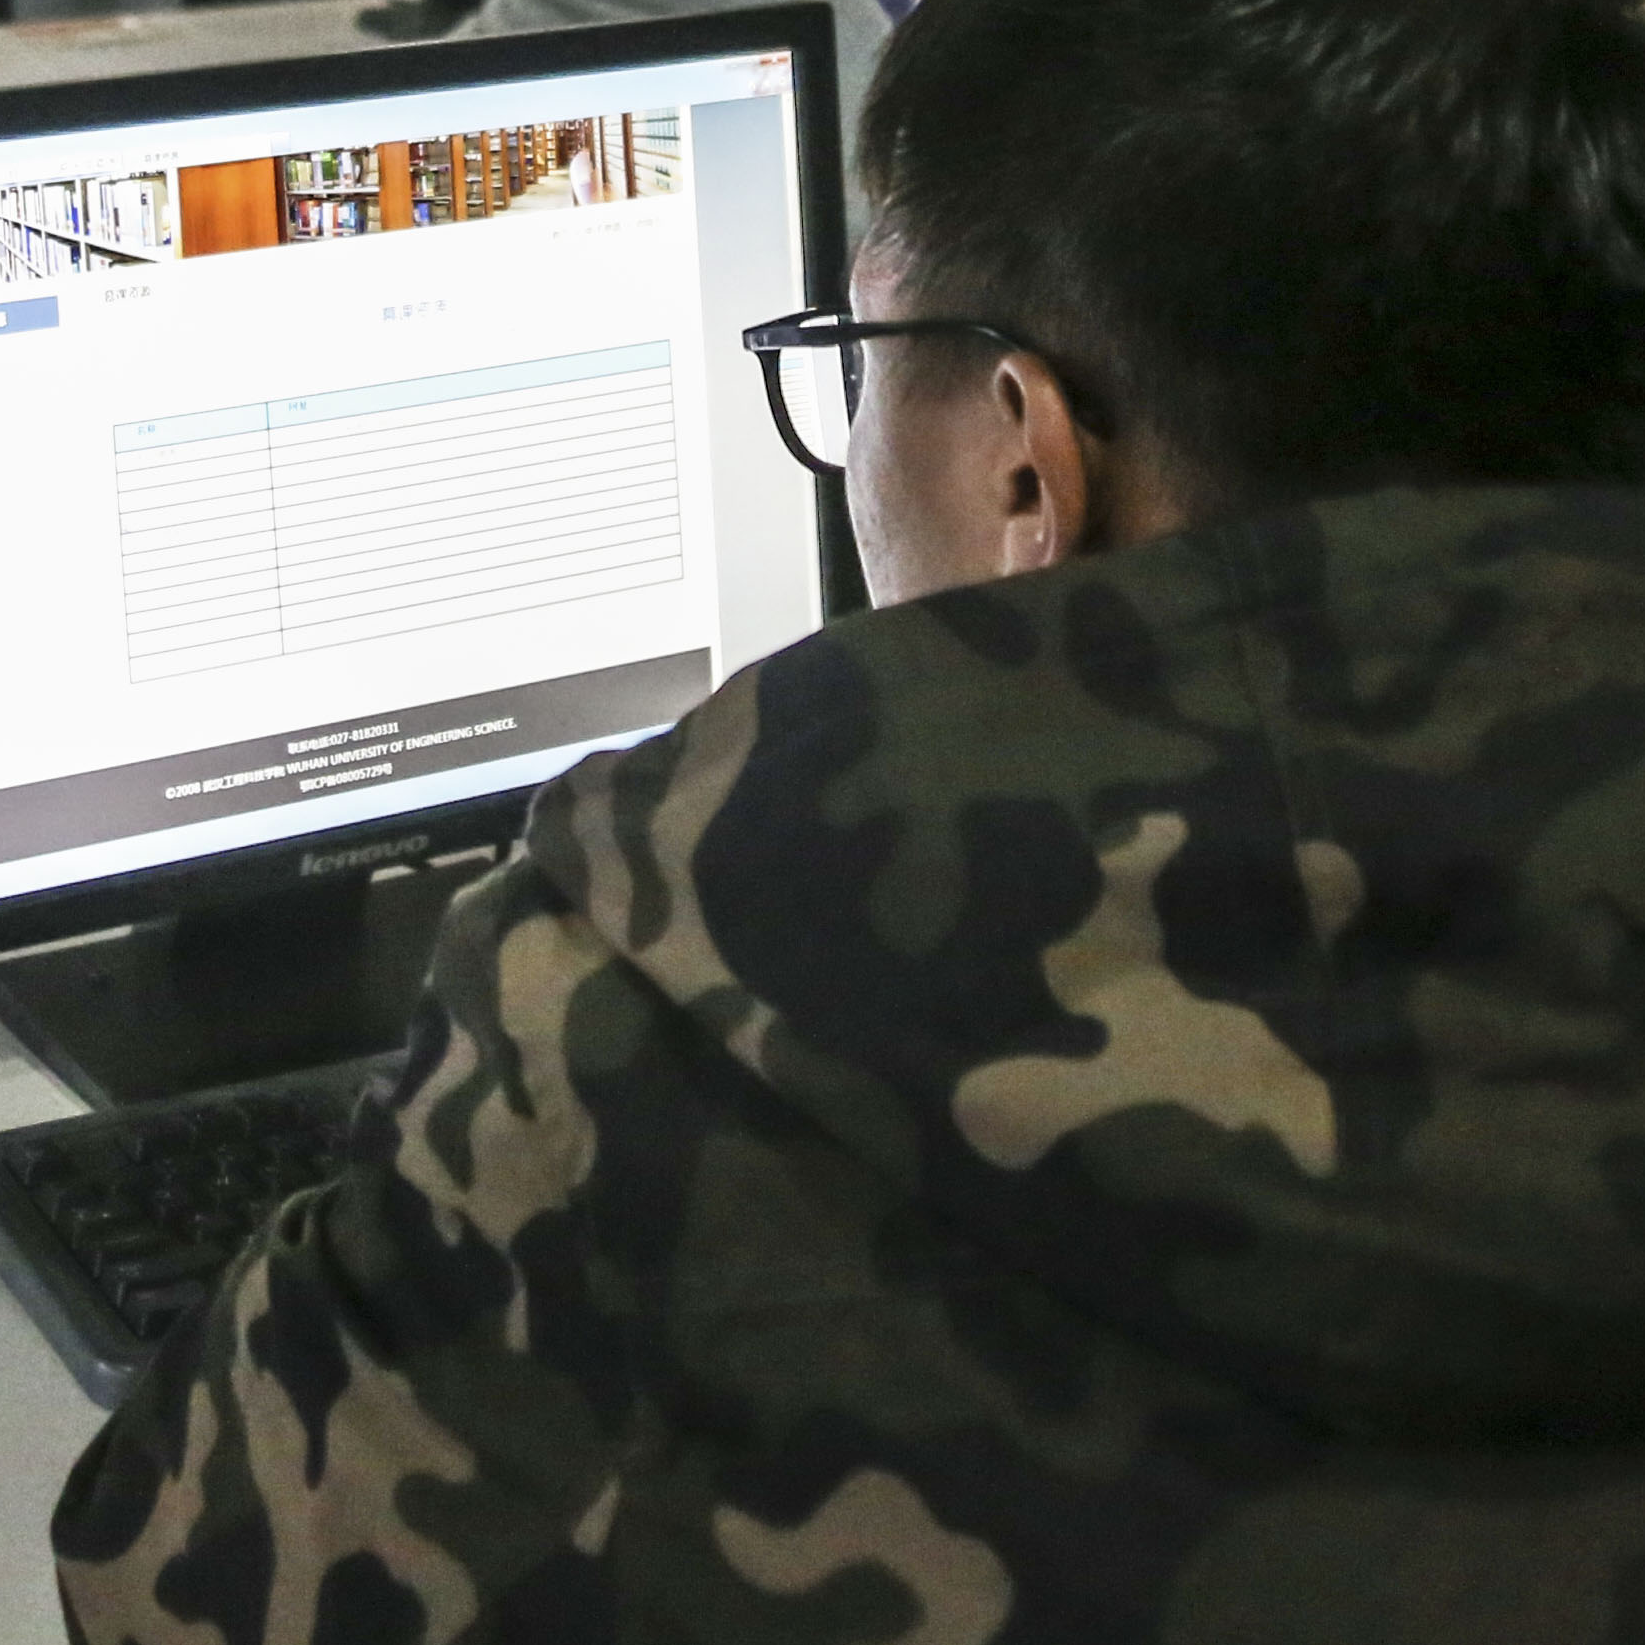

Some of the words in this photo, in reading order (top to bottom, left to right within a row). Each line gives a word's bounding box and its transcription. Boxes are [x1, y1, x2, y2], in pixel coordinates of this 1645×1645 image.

[286, 756, 328, 774] WUHAN
[330, 744, 389, 765] UNIVERSITY
[390, 739, 404, 754] OF
[406, 726, 473, 750] ENGINEERING
